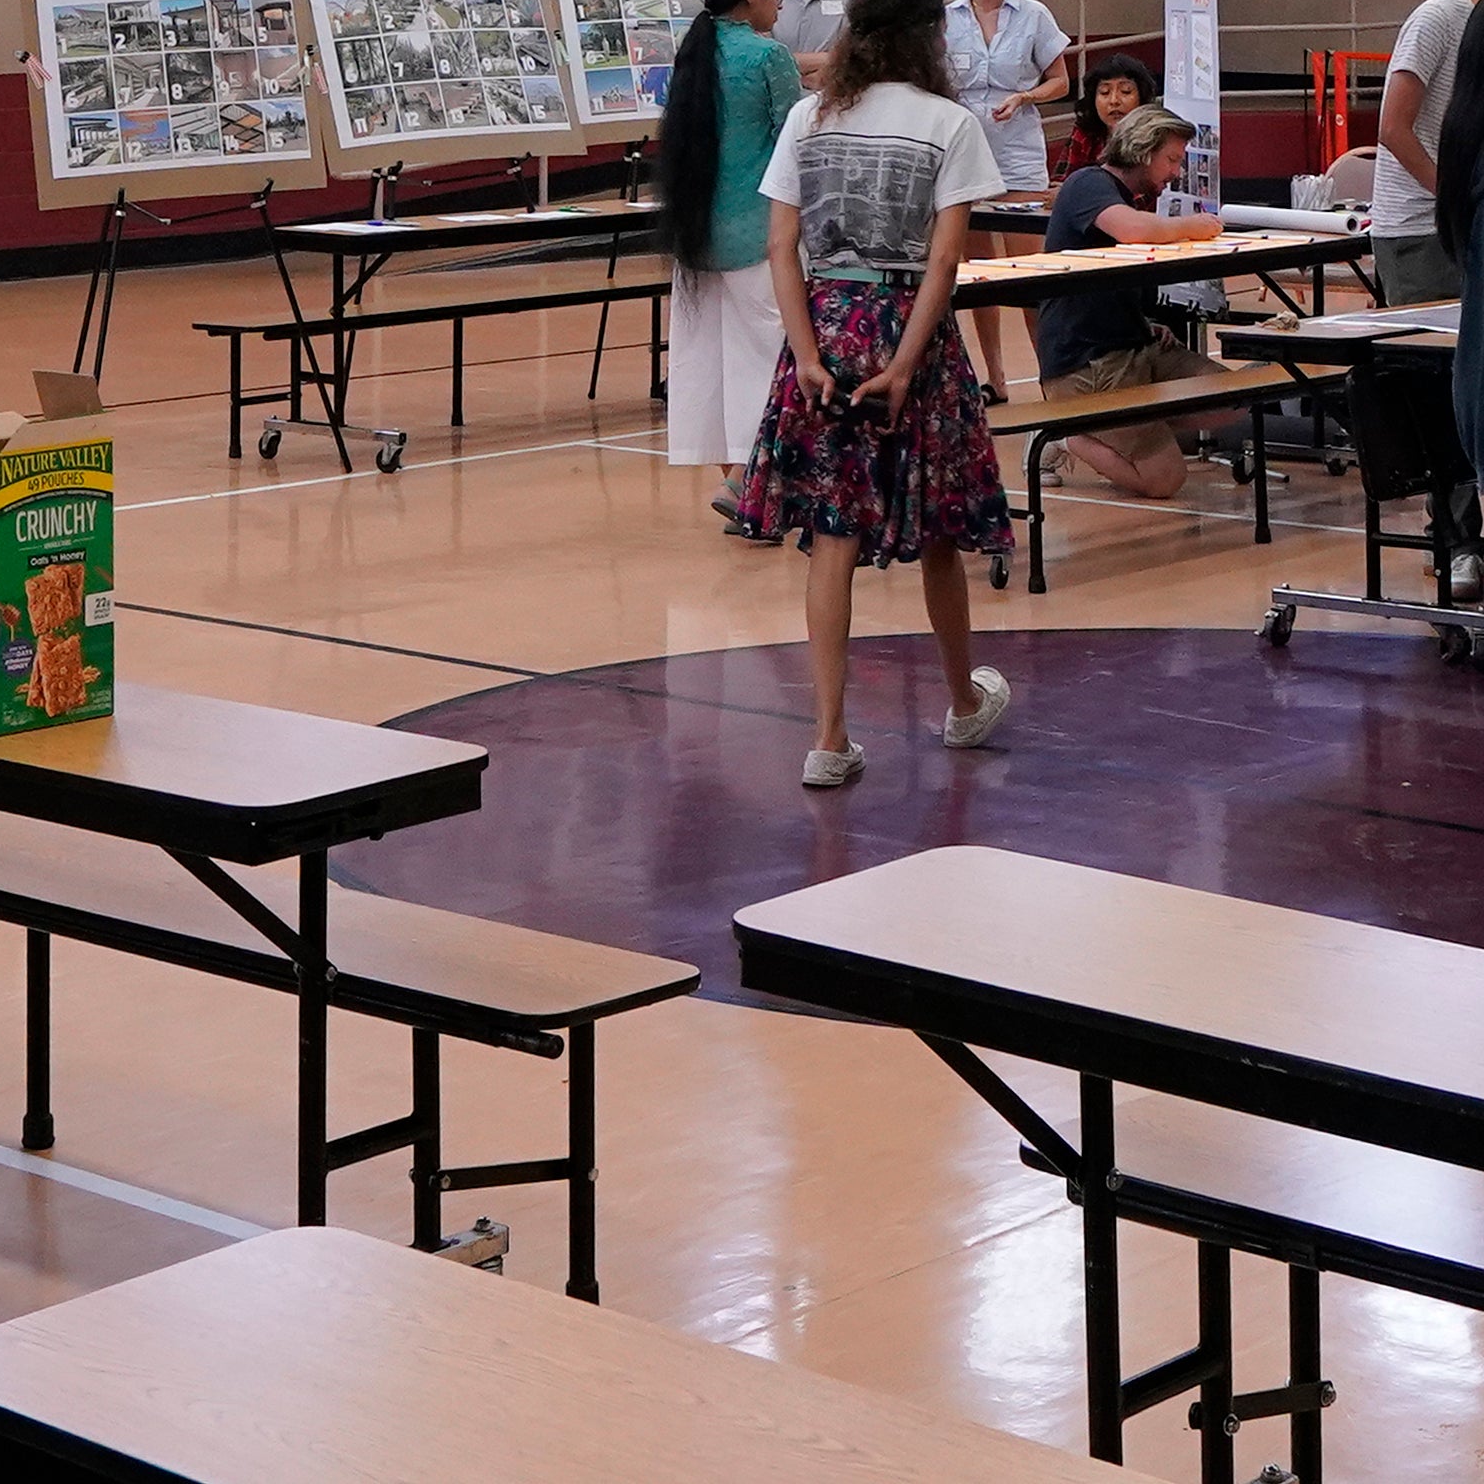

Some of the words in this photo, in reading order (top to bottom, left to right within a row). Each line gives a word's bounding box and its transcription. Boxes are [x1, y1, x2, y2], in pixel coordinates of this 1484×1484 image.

[672, 1, 682, 15] 3
[333, 19, 342, 35] 1
[383, 14, 395, 30] 2
[115, 33, 127, 50] 2
[166, 30, 177, 47] 3
[258, 26, 268, 44] 5
[633, 47, 643, 61] 7
[393, 62, 405, 78] 7
[440, 59, 451, 74] 8
[481, 57, 492, 72] 9
[520, 55, 537, 72] 10
[170, 83, 183, 101] 8
[264, 78, 280, 95] 10
[532, 104, 546, 120] 15
[0, 451, 59, 488] NATURE
[59, 444, 110, 471] VALLEY
[27, 478, 40, 491] 49
[41, 472, 85, 490] POUCHES
[16, 500, 97, 543] CRUNCHY
[30, 556, 49, 566] Oats
[59, 550, 86, 562] Honey
